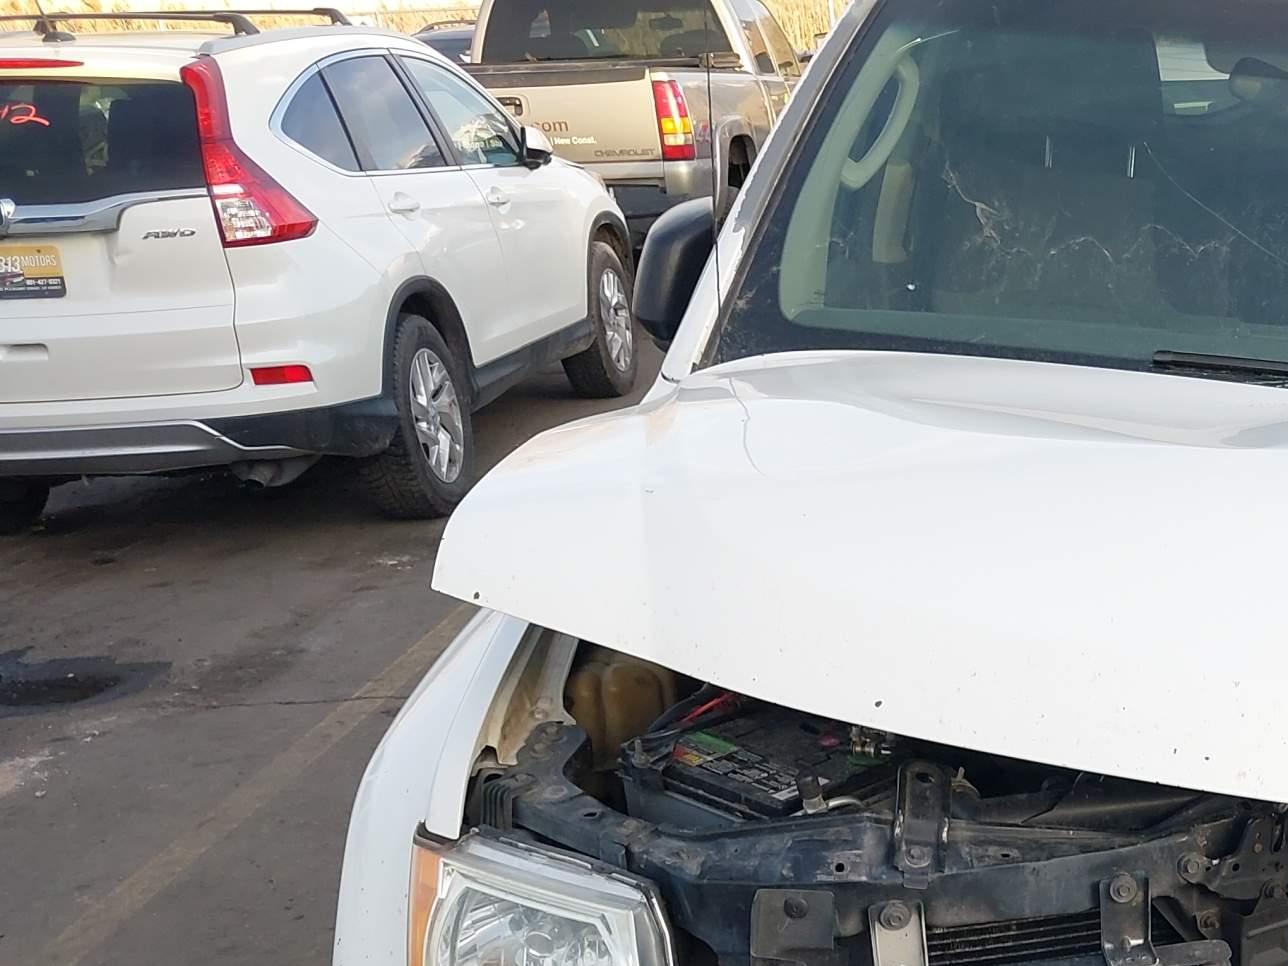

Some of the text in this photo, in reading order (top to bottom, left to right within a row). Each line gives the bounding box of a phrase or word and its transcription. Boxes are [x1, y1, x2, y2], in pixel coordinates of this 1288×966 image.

[594, 148, 656, 157] CHEVROLET
[142, 228, 197, 240] AWD
[20, 254, 57, 267] MOTORS
